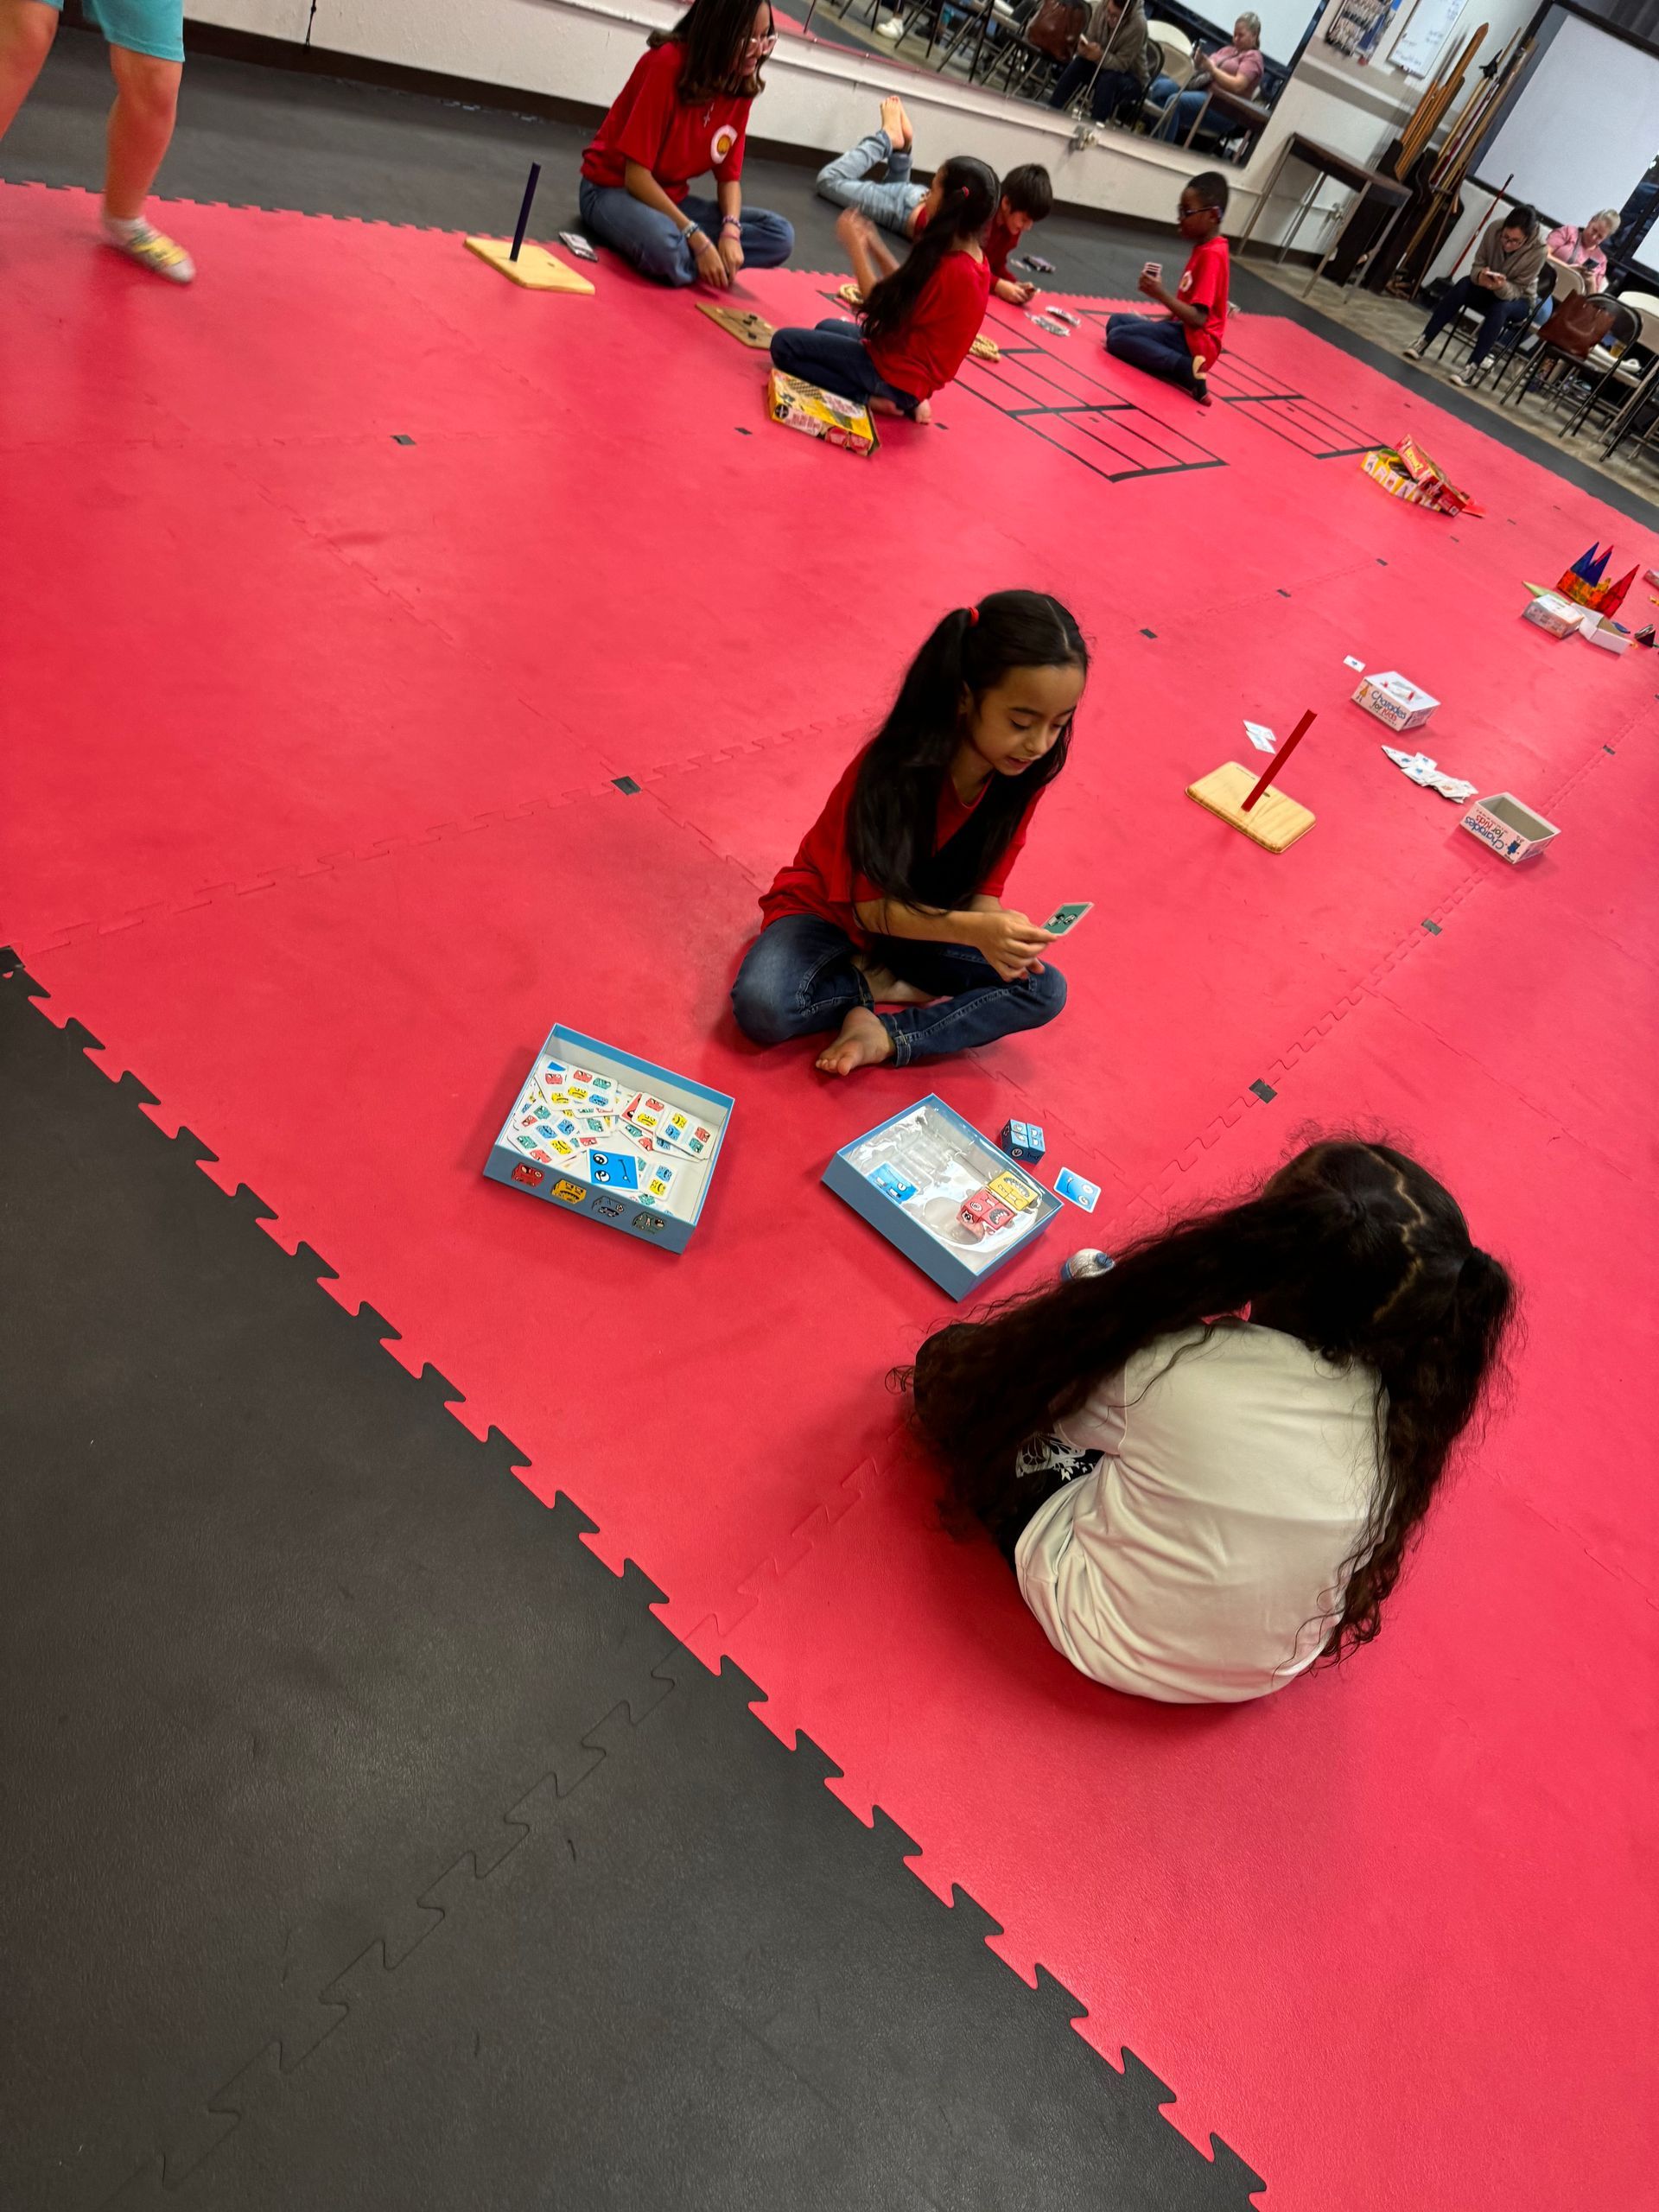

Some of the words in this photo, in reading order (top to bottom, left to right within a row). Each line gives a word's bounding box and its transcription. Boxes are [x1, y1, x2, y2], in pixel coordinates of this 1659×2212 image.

[1371, 690, 1407, 719] Charades
[1372, 701, 1382, 711] for
[1465, 816, 1504, 850] Charades
[1491, 827, 1504, 839] for
